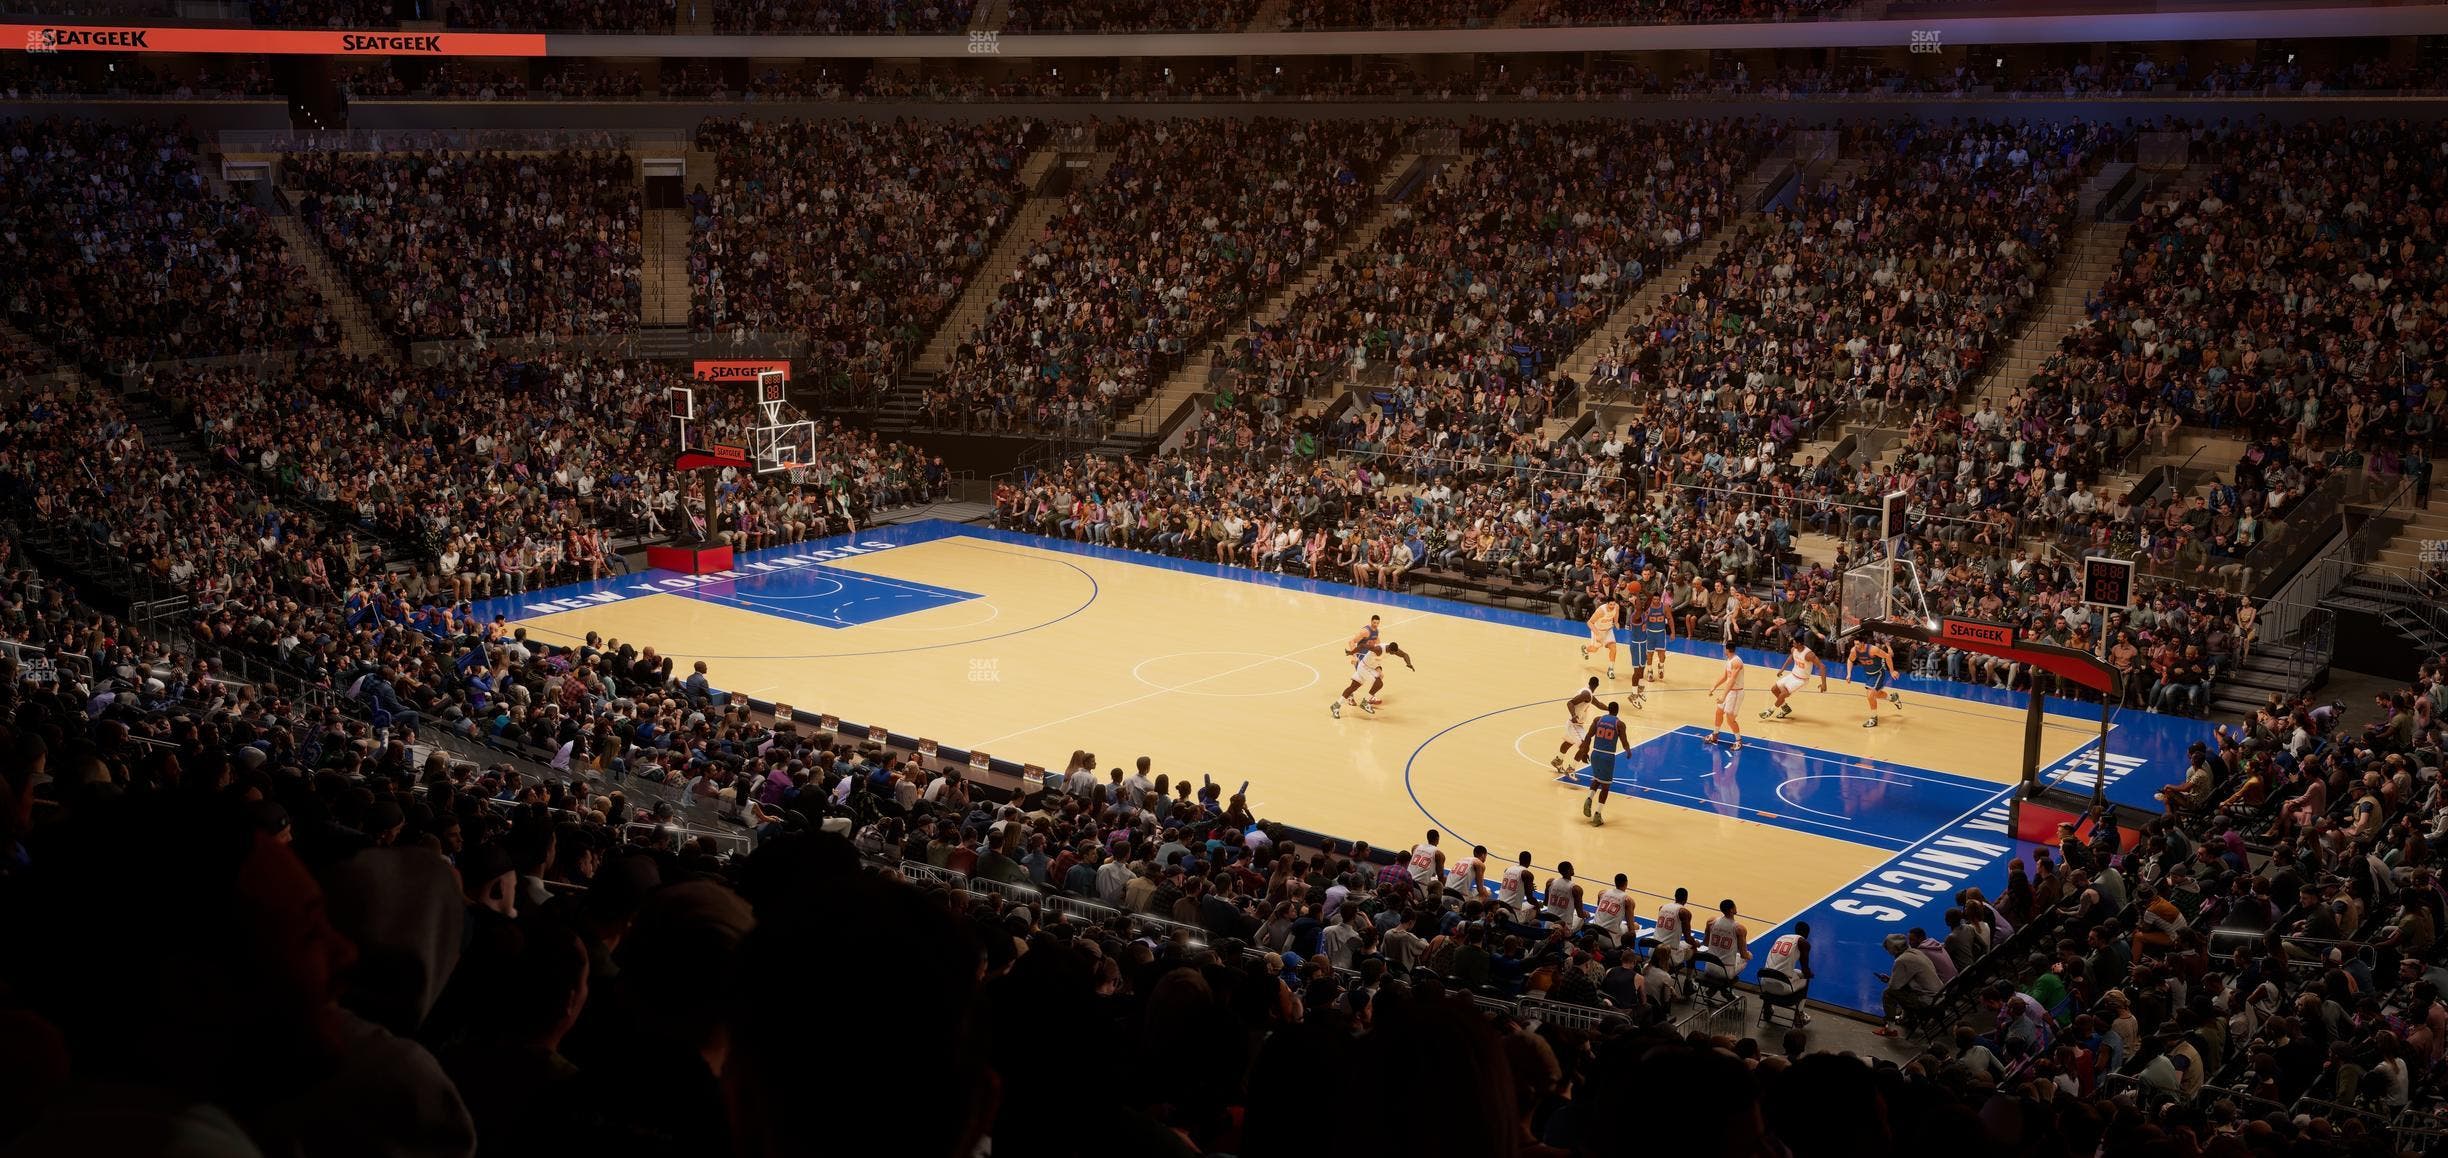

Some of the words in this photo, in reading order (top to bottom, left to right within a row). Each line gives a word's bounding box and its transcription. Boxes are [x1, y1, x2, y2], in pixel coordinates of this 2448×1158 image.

[42, 29, 149, 48] SEATGEEK
[342, 34, 442, 53] SEATGEEK
[711, 366, 774, 378] SEATGE
[524, 590, 627, 615] NEW
[627, 568, 750, 593] YORK
[747, 540, 896, 572] KNICKS
[1950, 623, 2004, 642] SEATGEEK
[1597, 727, 1614, 740] 00
[1829, 835, 2011, 922] KNICKS
